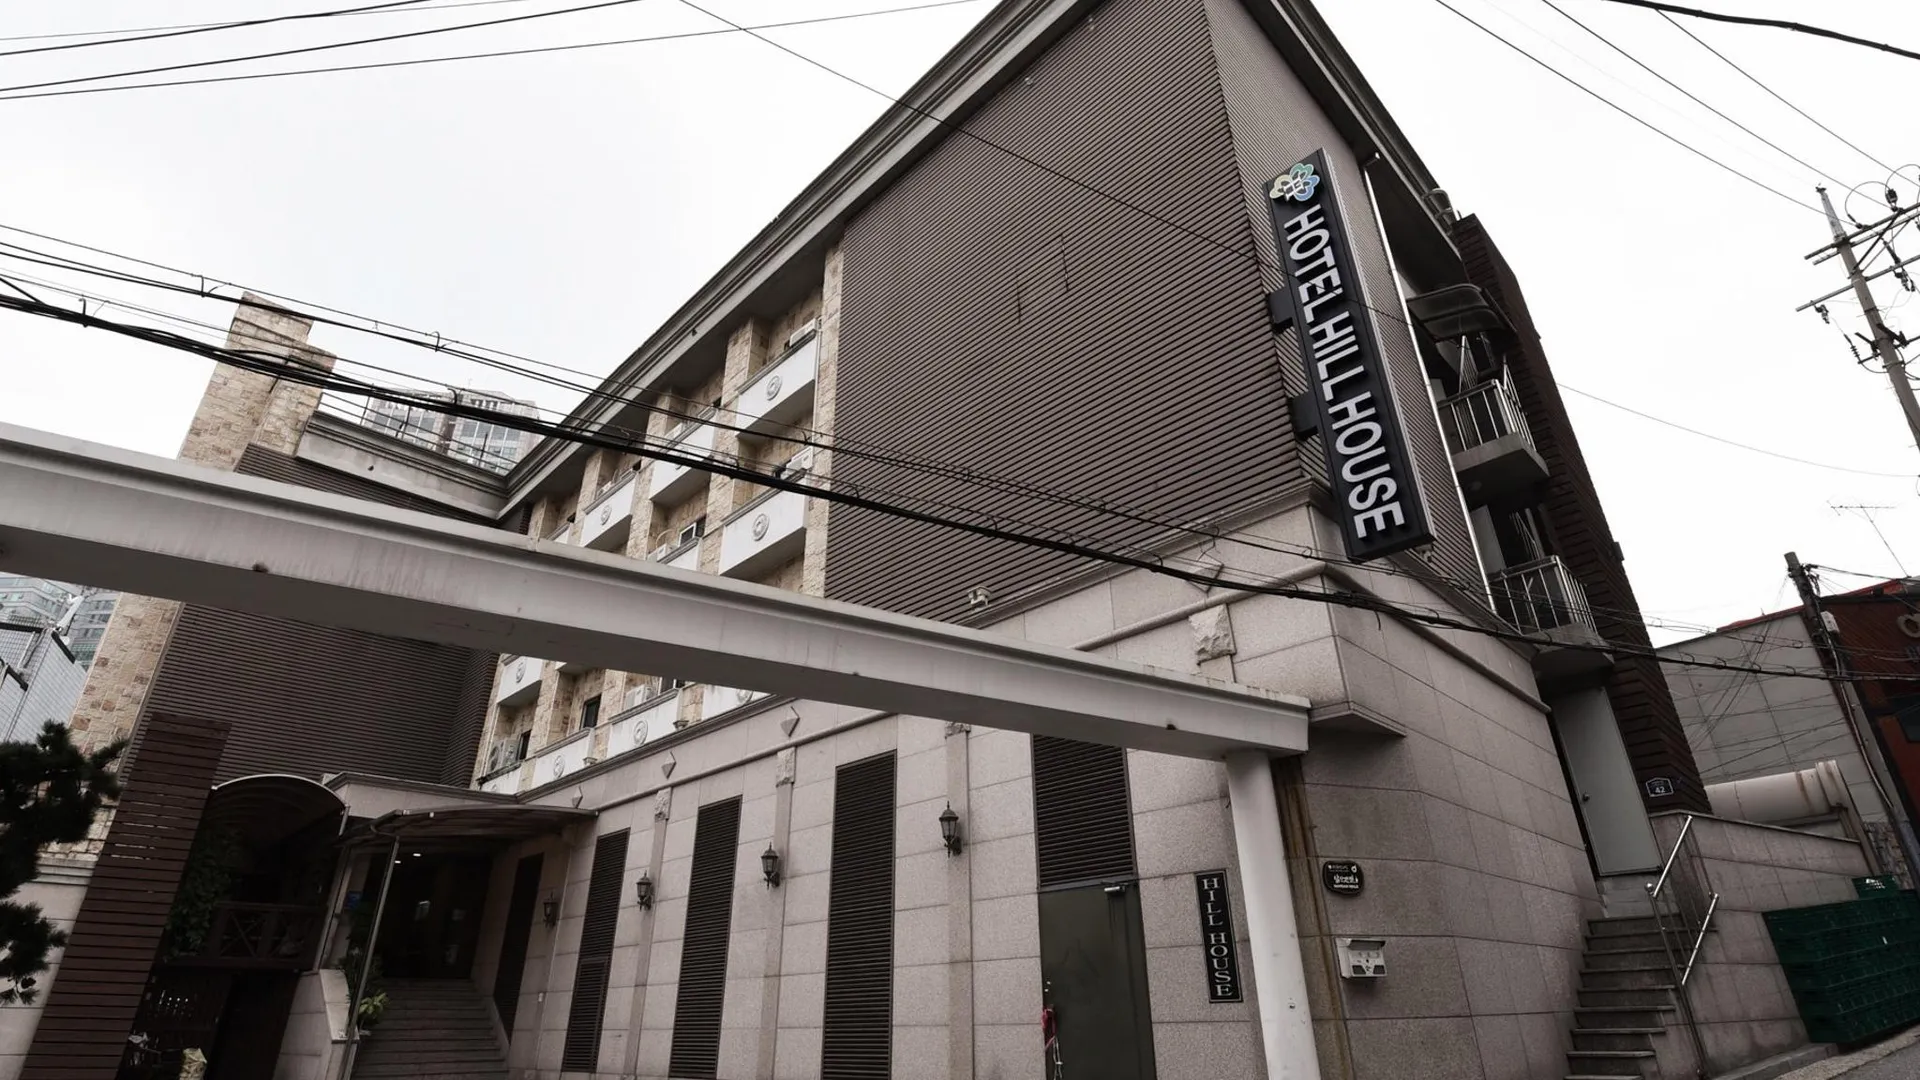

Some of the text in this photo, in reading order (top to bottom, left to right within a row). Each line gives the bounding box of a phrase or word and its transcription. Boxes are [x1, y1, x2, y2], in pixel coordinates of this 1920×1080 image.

[1284, 204, 1406, 539] HOTEL HILL HOUSE
[1202, 877, 1233, 997] HILL HOUSE
